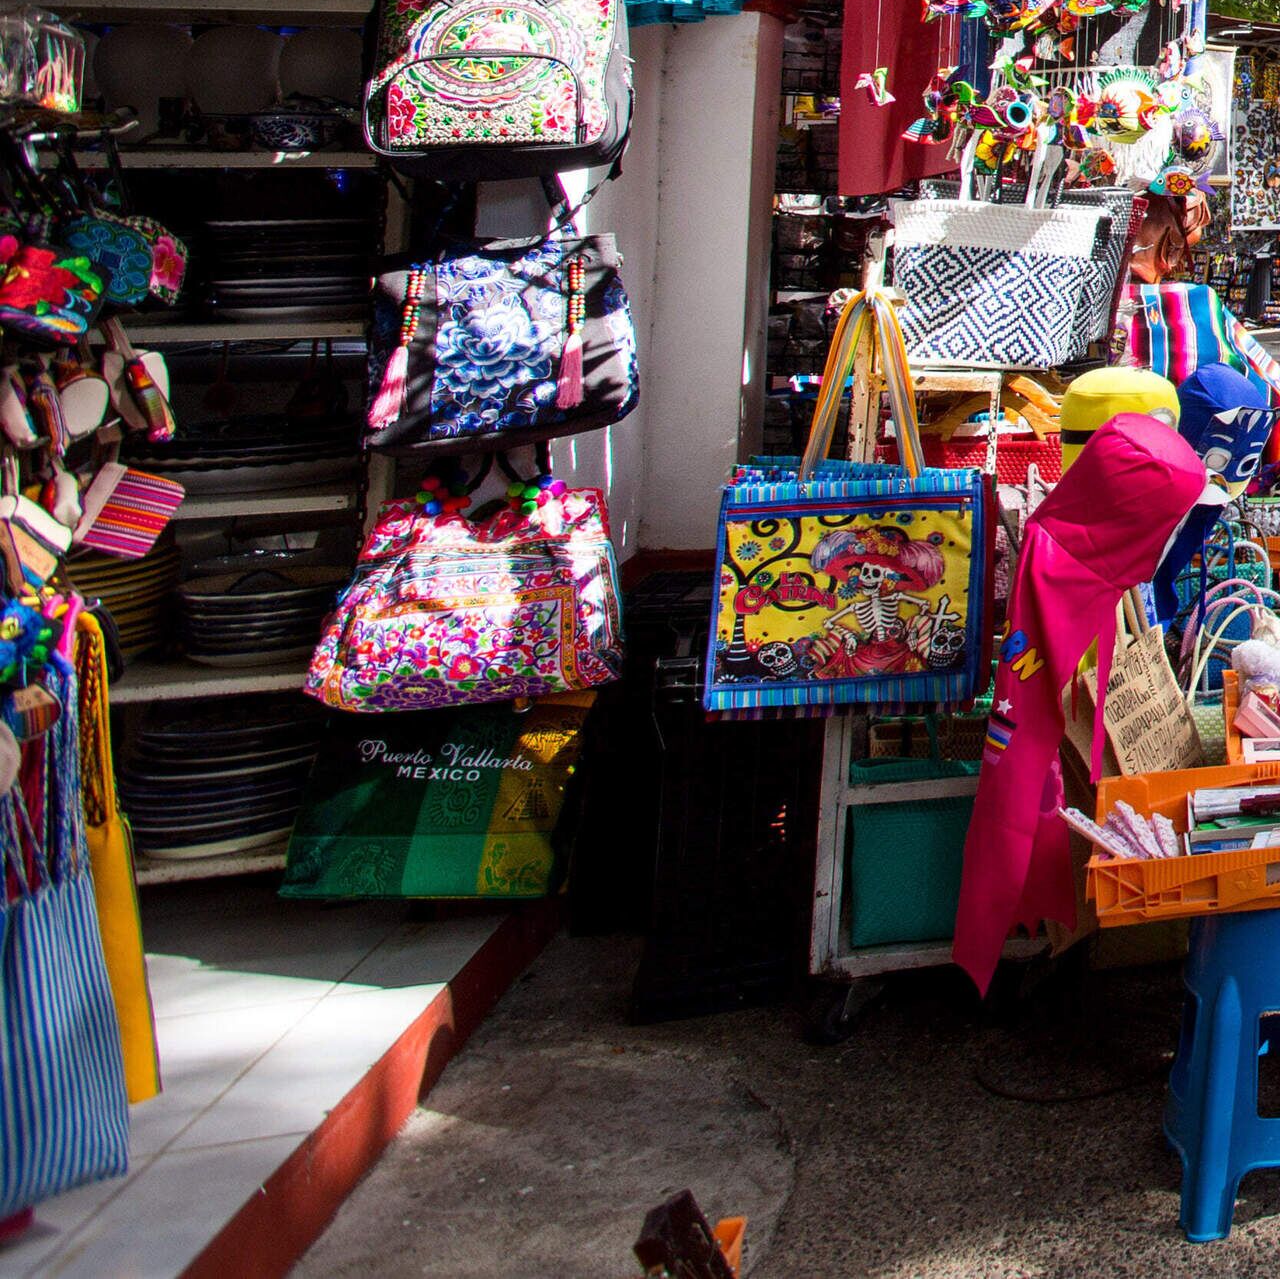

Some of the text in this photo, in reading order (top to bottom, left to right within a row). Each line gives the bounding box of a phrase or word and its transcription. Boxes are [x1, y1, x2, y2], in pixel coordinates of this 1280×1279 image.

[779, 572, 803, 585] LA
[357, 739, 535, 771] Puerto Vallarta
[396, 765, 480, 782] MEXICO
